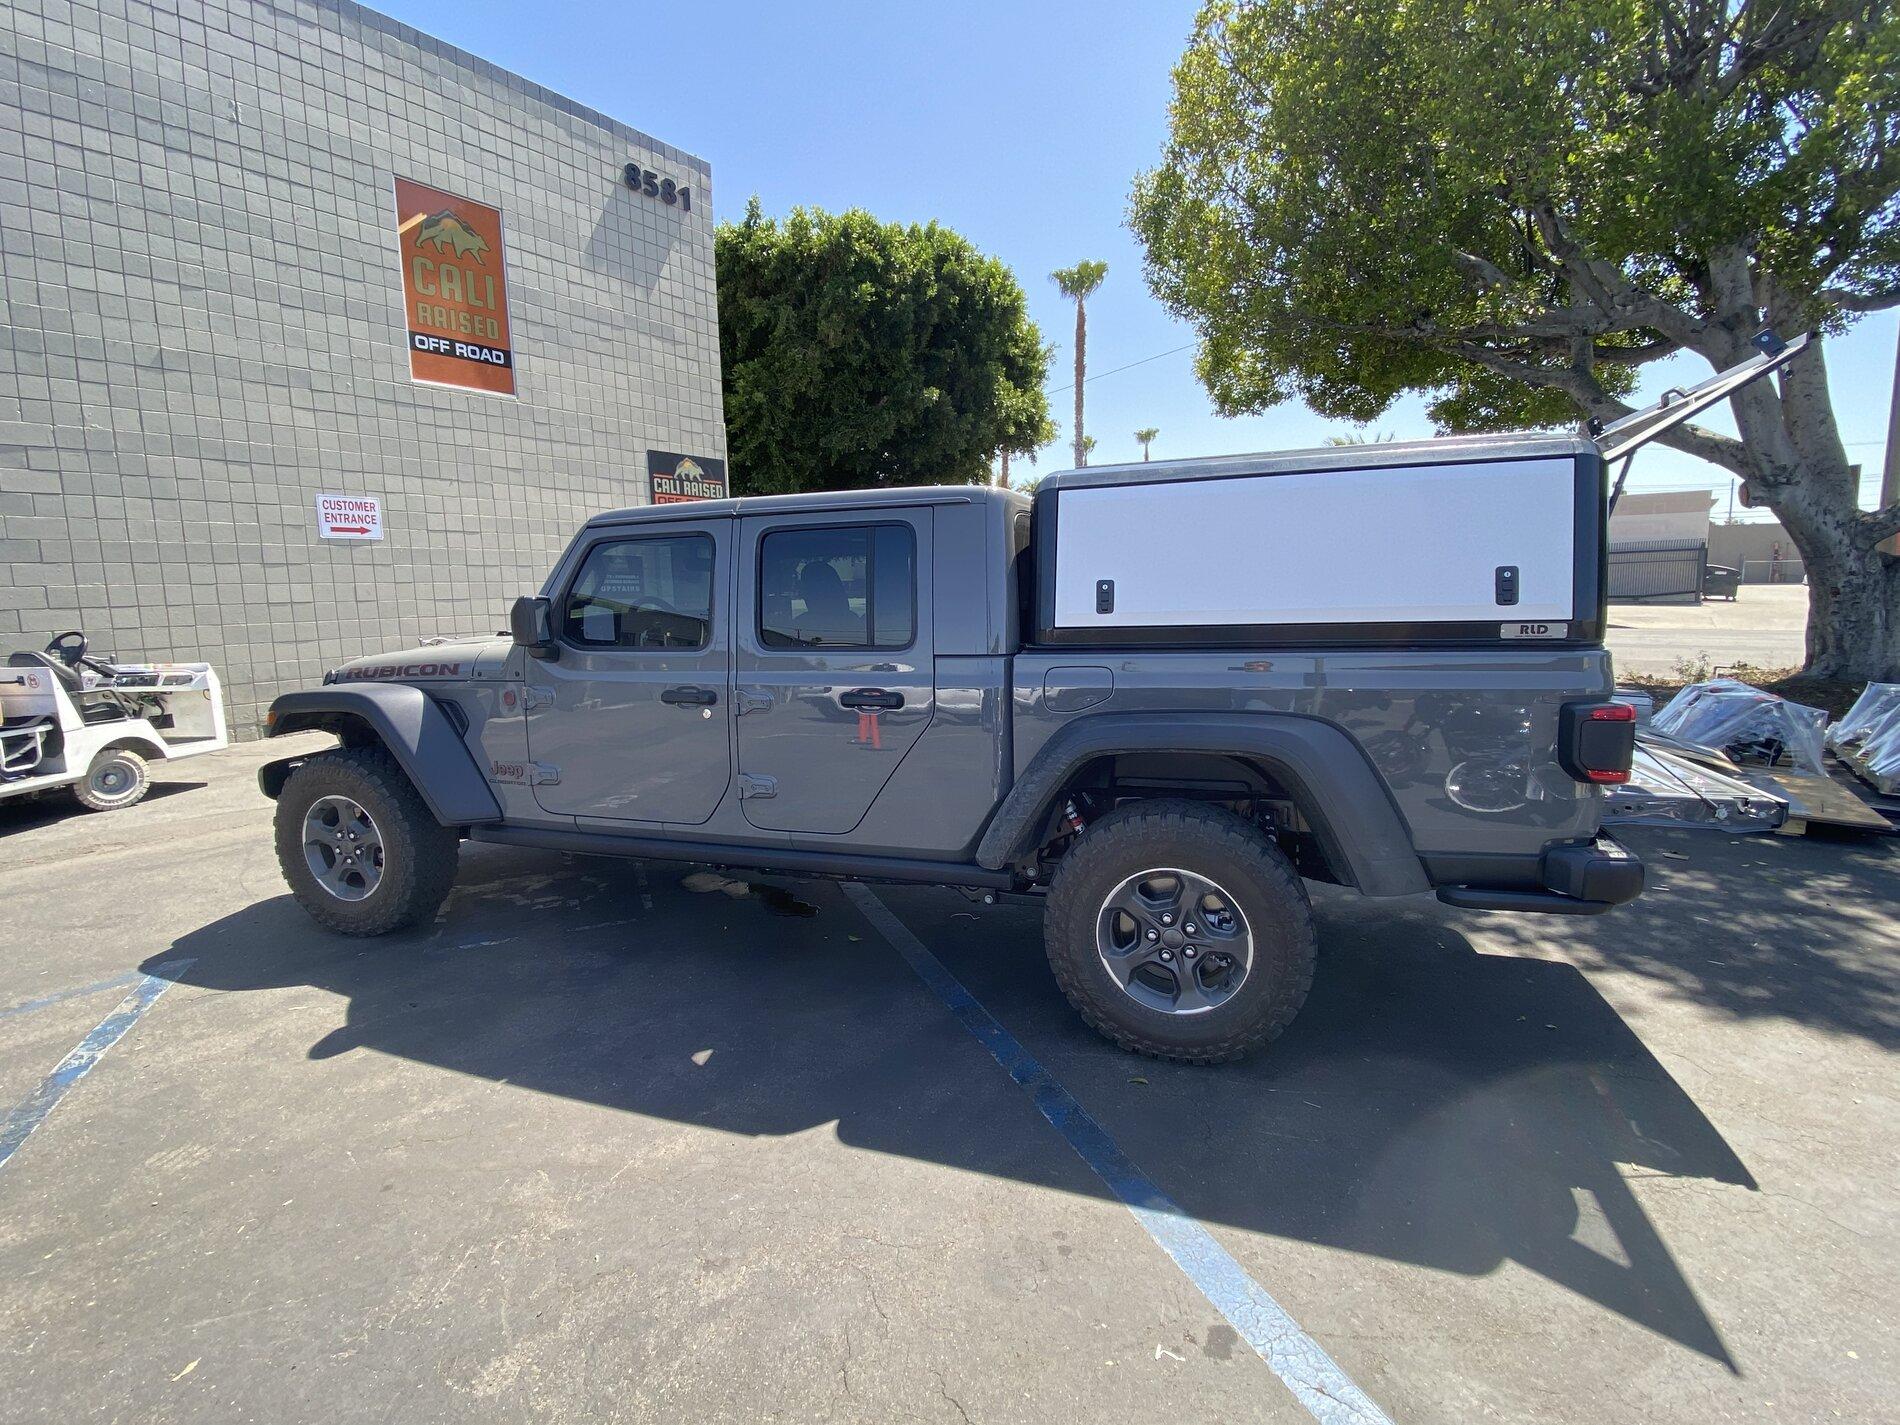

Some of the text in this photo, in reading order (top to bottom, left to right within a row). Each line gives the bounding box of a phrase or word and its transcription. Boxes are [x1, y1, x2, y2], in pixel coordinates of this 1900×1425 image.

[624, 163, 691, 211] 8581
[412, 256, 496, 311] CALI
[416, 302, 499, 340] RAISED
[414, 334, 505, 364] OFF ROAD
[653, 477, 723, 499] CALI RAISED
[322, 500, 376, 512] CUSTOMER
[324, 512, 377, 525] ENTRANCE
[346, 663, 461, 679] RUBICON
[489, 760, 524, 780] Jeep
